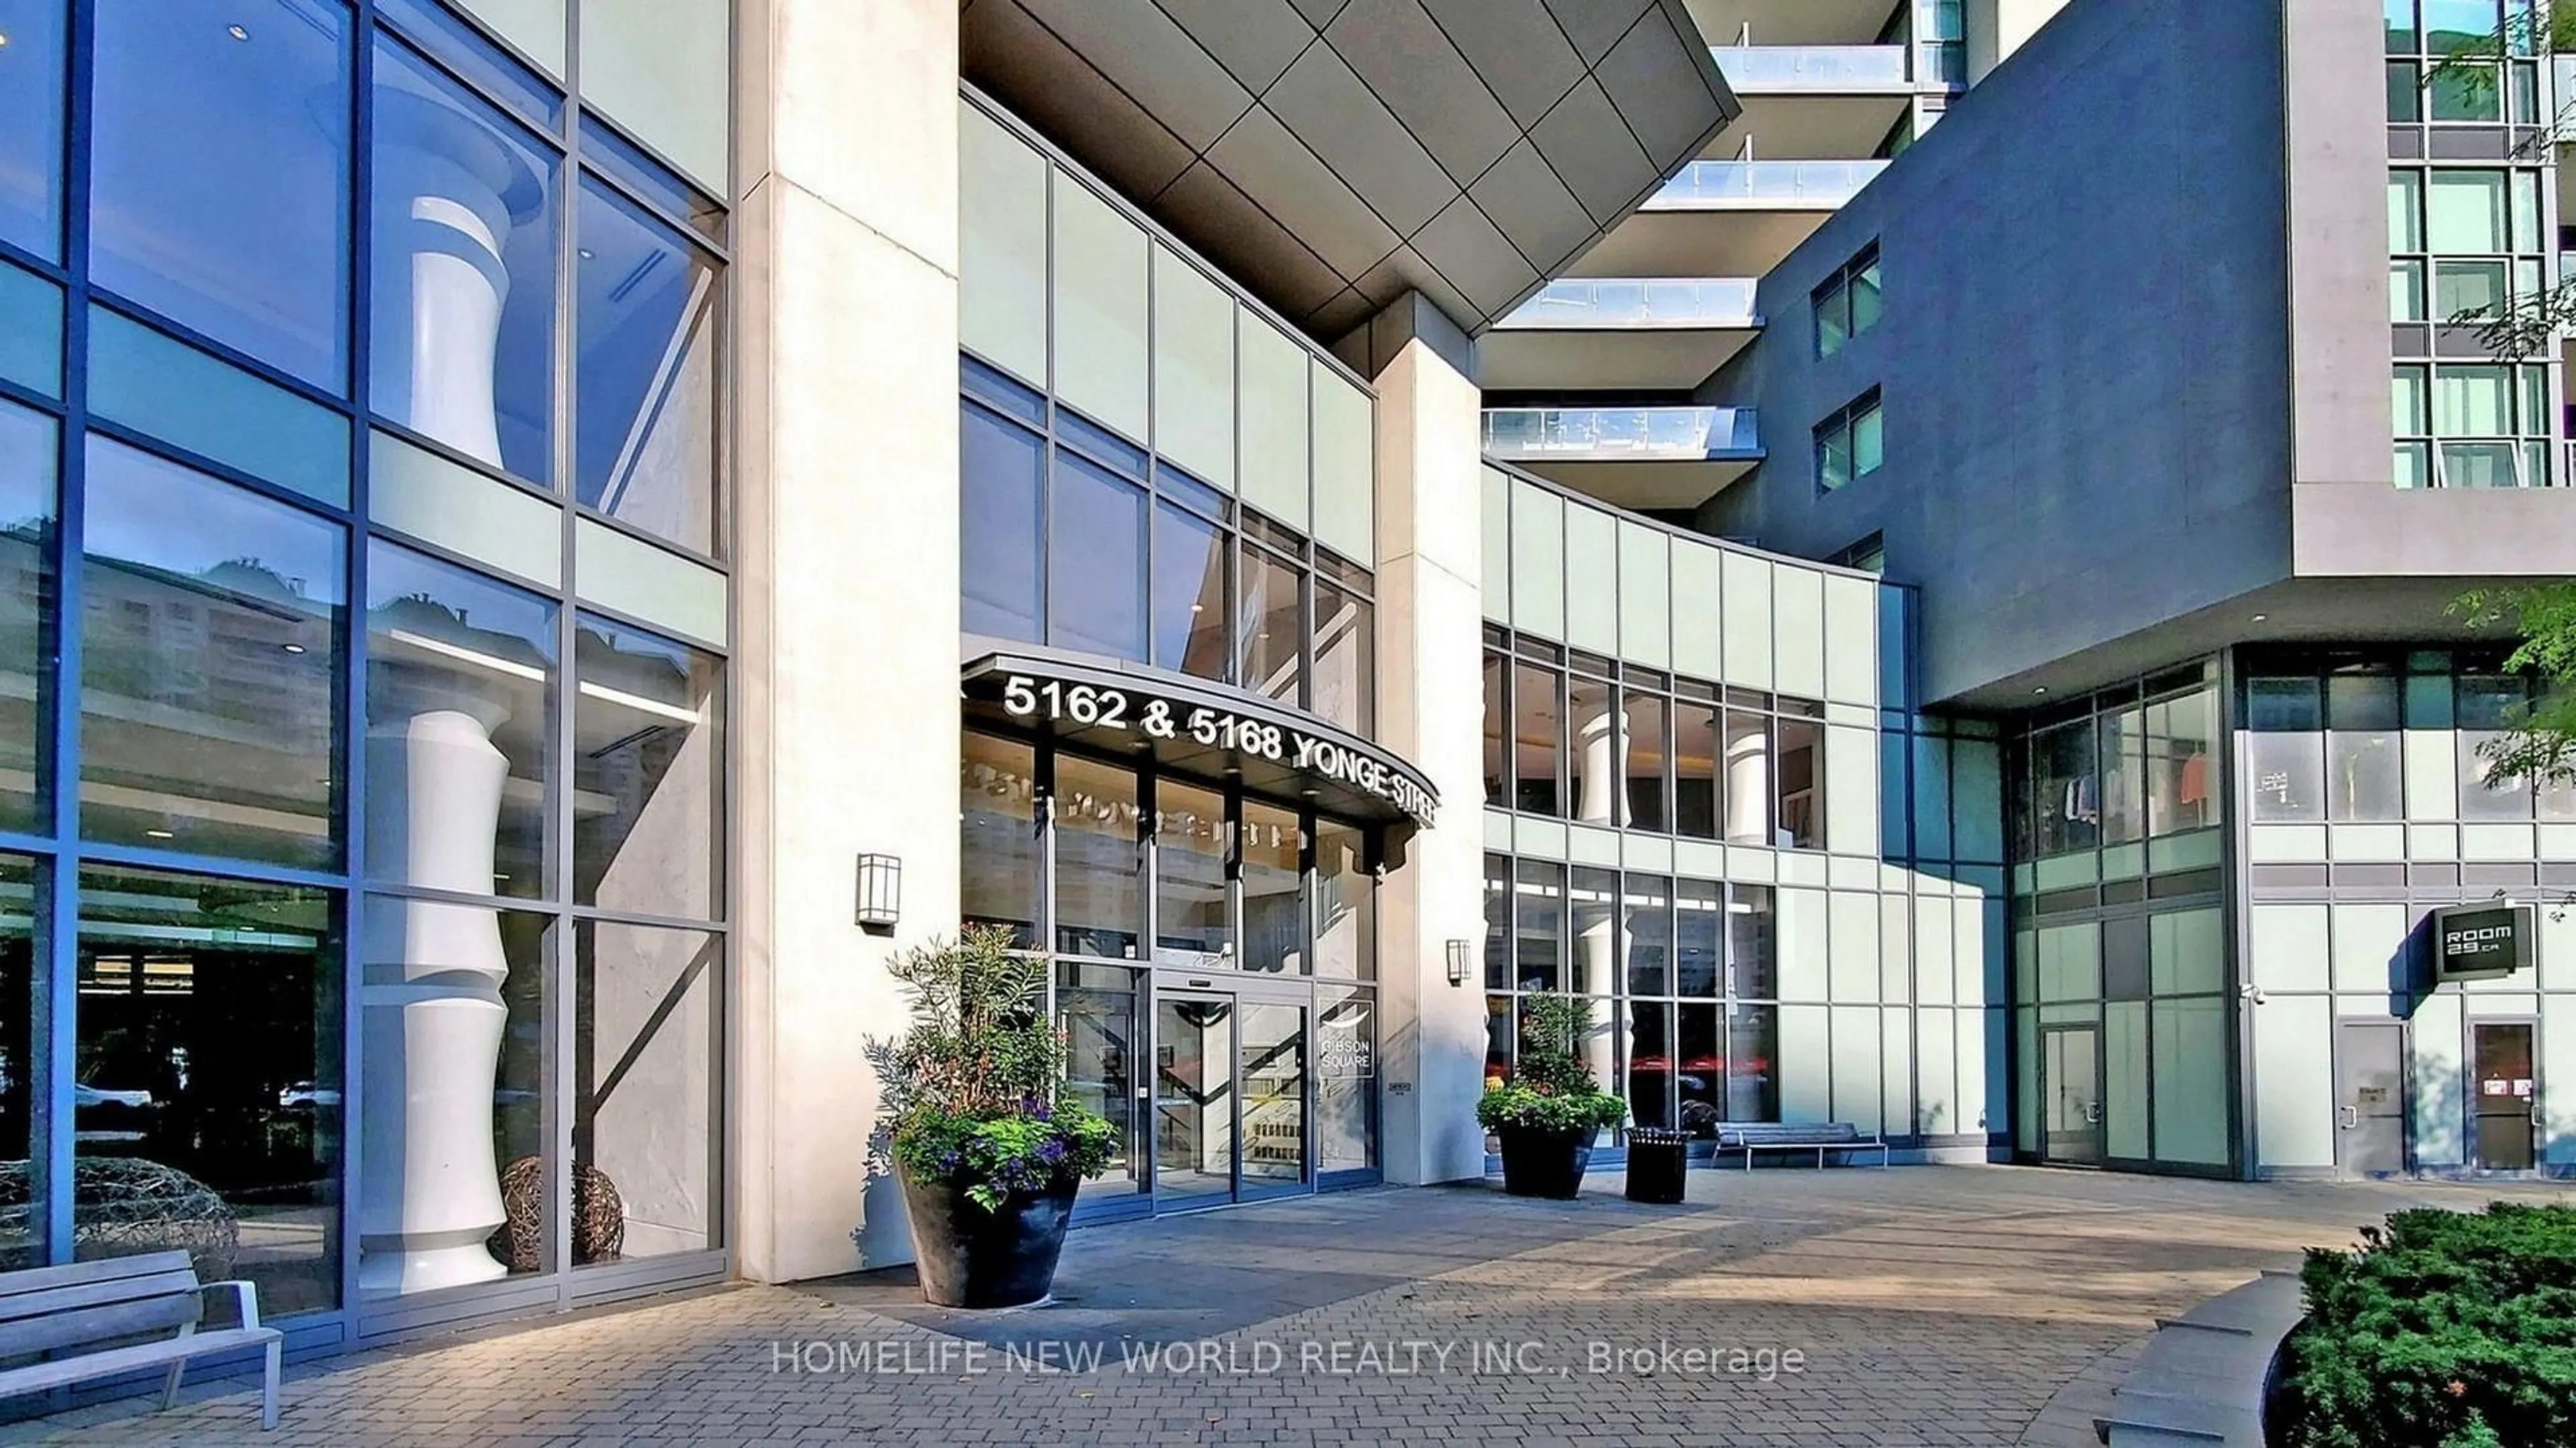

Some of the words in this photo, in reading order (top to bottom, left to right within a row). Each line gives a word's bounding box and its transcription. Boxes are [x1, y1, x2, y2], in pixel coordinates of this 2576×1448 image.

[1004, 676, 1127, 729] 5162
[1140, 700, 1175, 738] &
[1187, 709, 1282, 760] 5168
[1293, 733, 1389, 796] YONGE
[1389, 773, 1436, 823] STREE
[2447, 926, 2511, 943] ROOM
[1322, 1041, 1369, 1053] GIBSON
[1322, 1055, 1370, 1068] SQUARE
